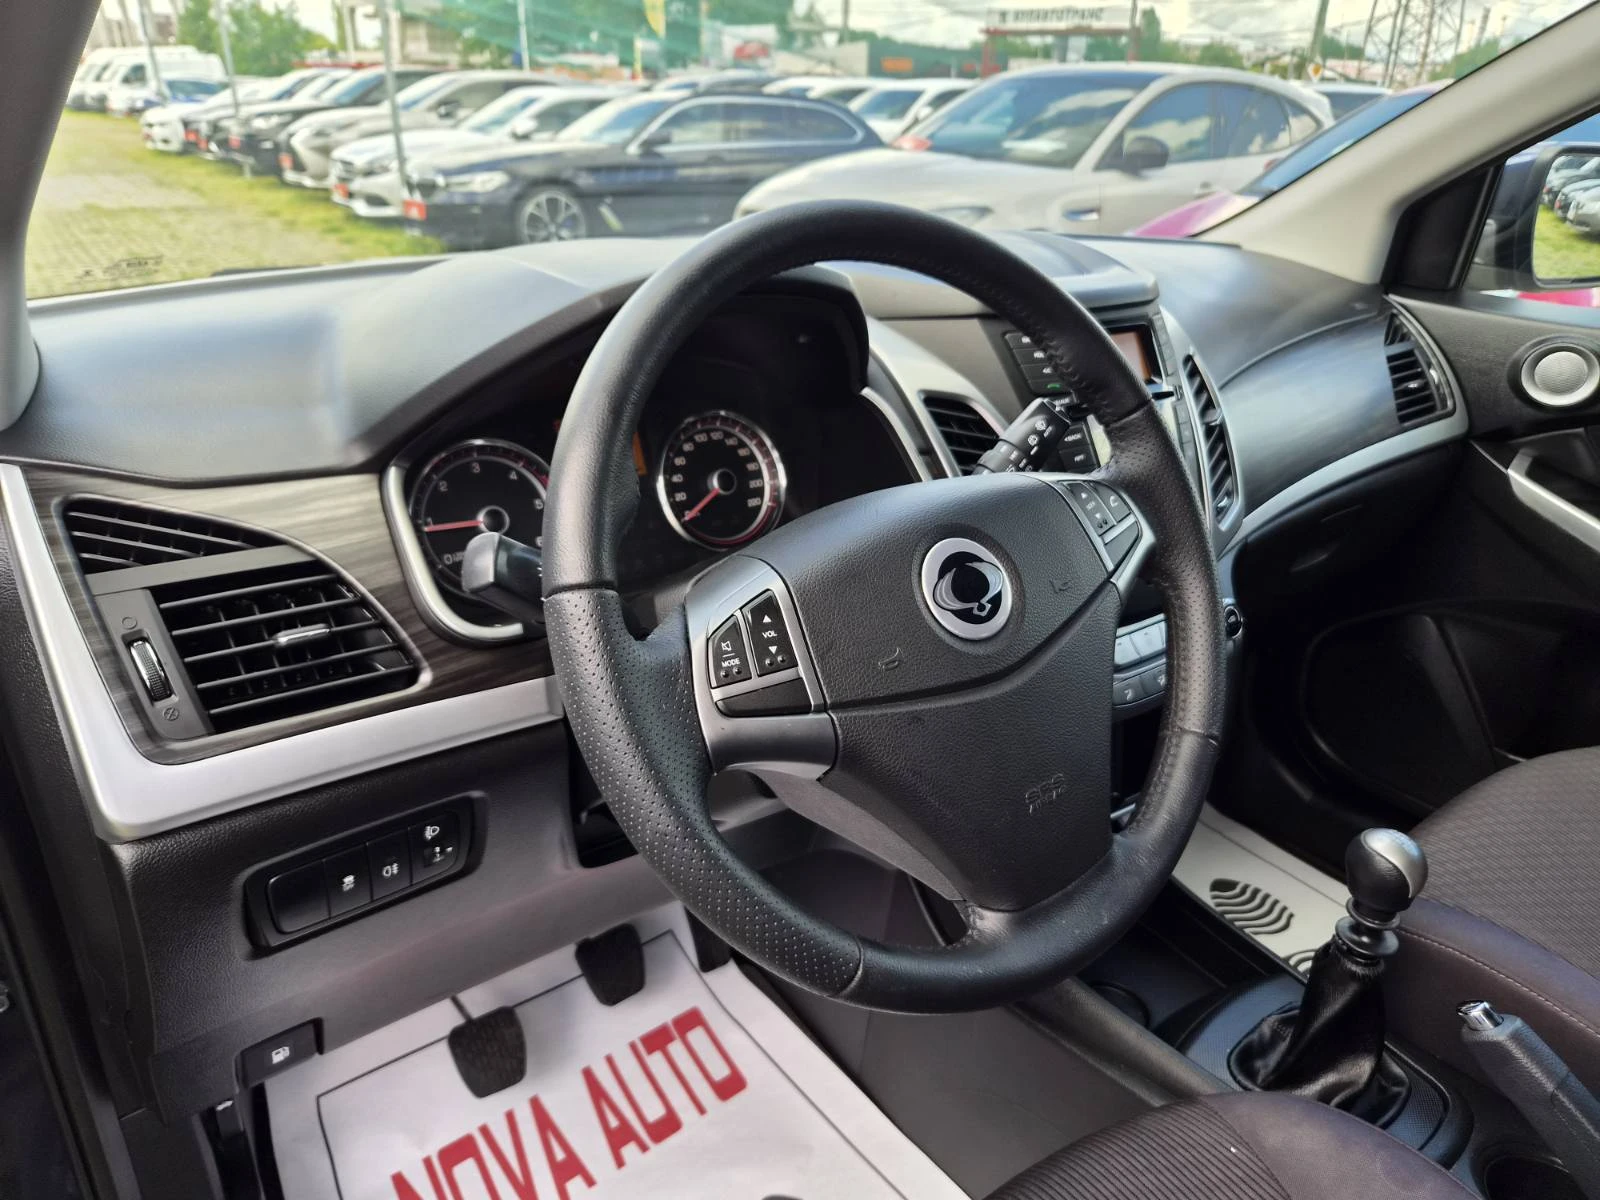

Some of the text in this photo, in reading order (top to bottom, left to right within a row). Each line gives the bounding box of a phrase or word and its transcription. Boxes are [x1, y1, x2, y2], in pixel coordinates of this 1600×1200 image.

[471, 462, 481, 474] 3
[508, 470, 518, 481] 4
[438, 480, 449, 492] 2
[674, 492, 687, 502] 20
[443, 553, 454, 565] 0
[761, 629, 778, 639] VOL
[721, 657, 742, 668] MODE
[581, 1006, 748, 1170] AUTO
